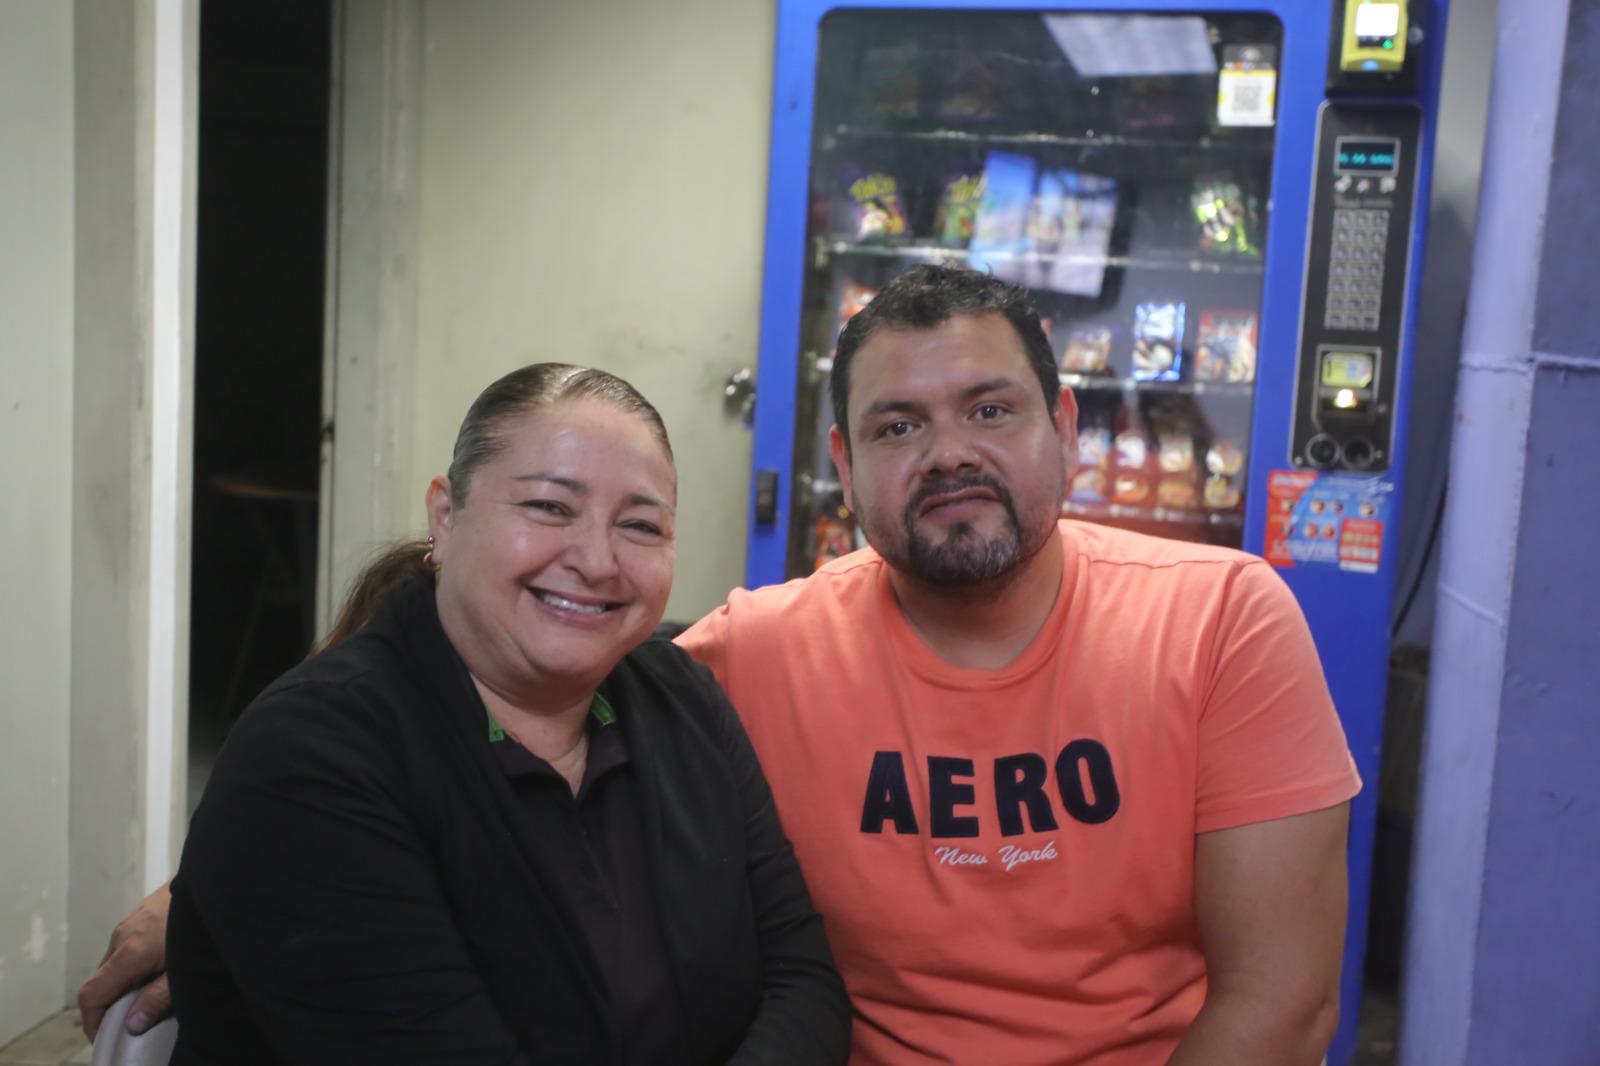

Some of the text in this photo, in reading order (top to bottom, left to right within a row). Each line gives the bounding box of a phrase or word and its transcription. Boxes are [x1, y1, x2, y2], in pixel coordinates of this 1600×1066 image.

[860, 738, 1120, 838] AERO
[934, 841, 1058, 872] New York
